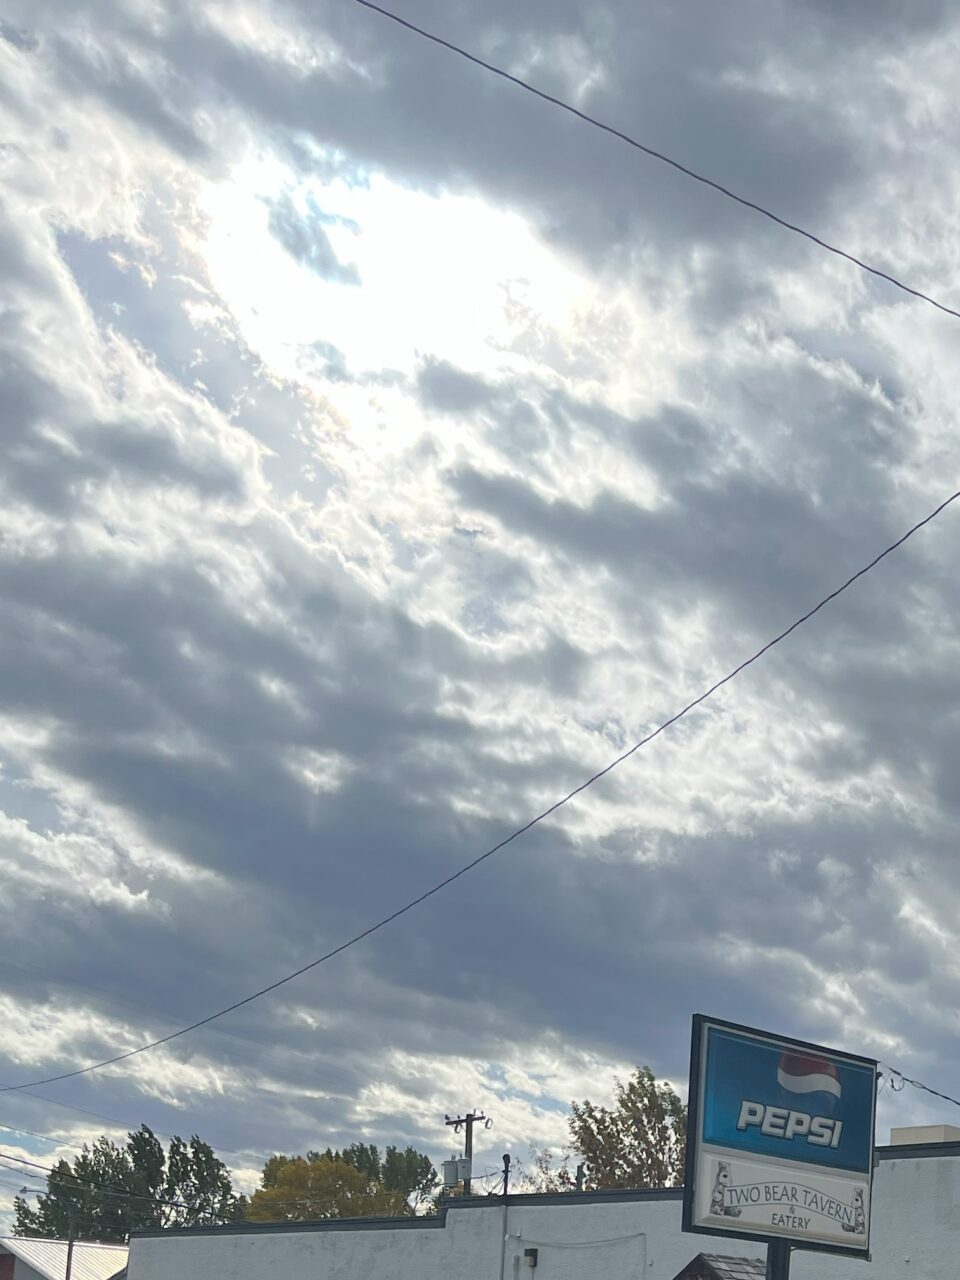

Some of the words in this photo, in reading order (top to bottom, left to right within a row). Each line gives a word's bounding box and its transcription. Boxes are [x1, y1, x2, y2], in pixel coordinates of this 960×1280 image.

[736, 1100, 844, 1149] PEPSI
[727, 1186, 761, 1205] TWO
[764, 1185, 799, 1202] BEAR
[803, 1189, 854, 1224] TAVERN
[788, 1205, 796, 1215] &
[771, 1213, 811, 1230] EATERY
